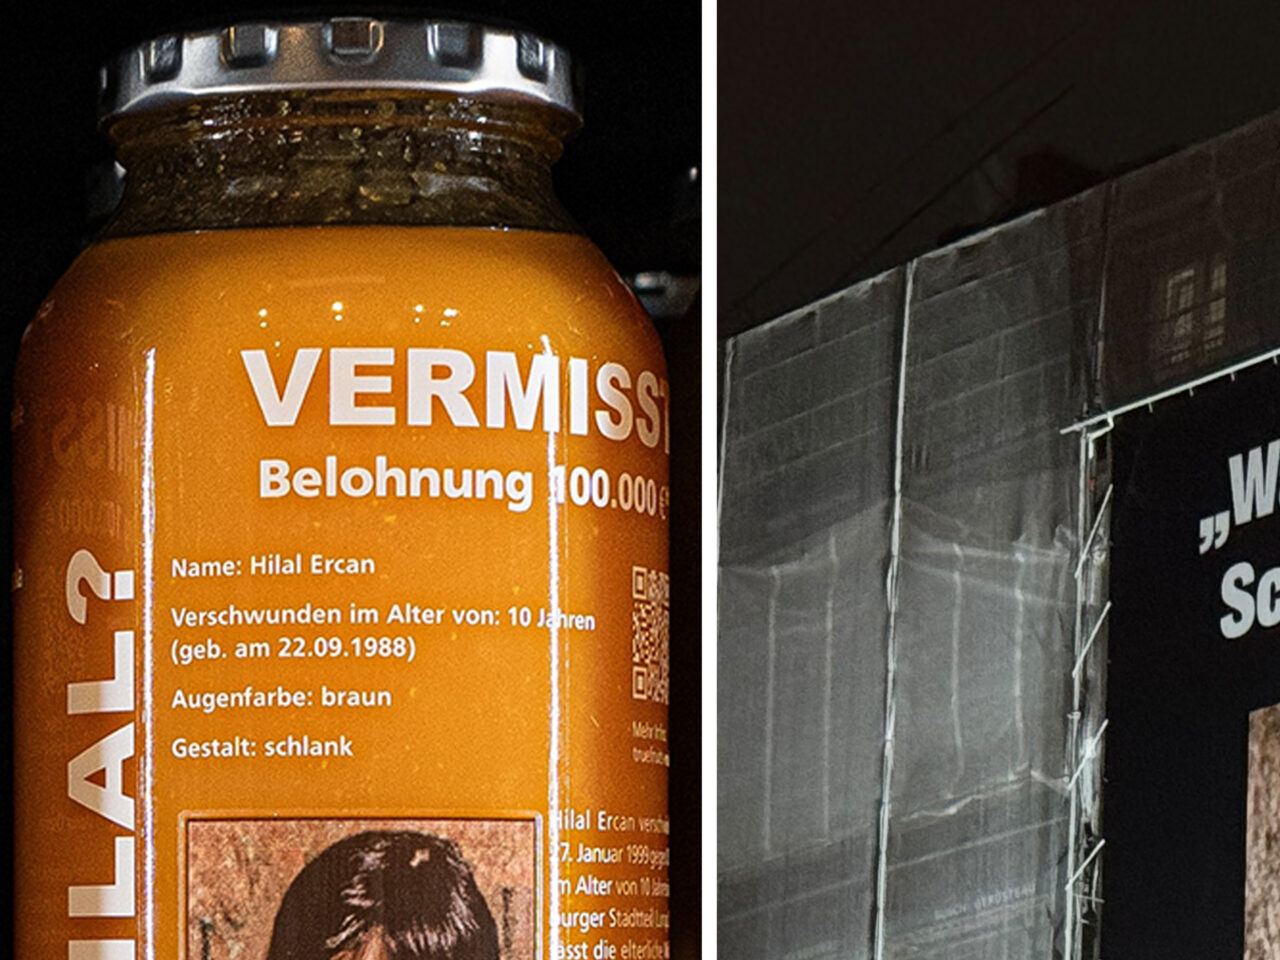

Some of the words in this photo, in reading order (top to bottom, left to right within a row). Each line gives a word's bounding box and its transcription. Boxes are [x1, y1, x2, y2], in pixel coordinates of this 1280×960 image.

[259, 456, 533, 513] Belohnung
[551, 465, 657, 516] 100.000
[171, 558, 242, 578] Name:
[250, 553, 301, 575] Hilal
[311, 554, 375, 574] Ercan
[171, 604, 342, 627] Verschwunden
[350, 603, 379, 623] im
[386, 603, 445, 624] Alter
[452, 609, 500, 625] von:
[508, 607, 532, 627] 10
[537, 607, 596, 631] Jahren
[171, 638, 227, 665] (geb.
[235, 642, 270, 657] am
[278, 636, 416, 662] 22.09.1988)
[171, 686, 313, 713] Augenfarbe:
[321, 686, 392, 707] braun
[171, 736, 256, 758] Gestalt:
[264, 735, 353, 756] schlank
[598, 810, 635, 832] Ercan
[577, 843, 623, 863] Januar
[575, 875, 613, 895] Alter
[615, 880, 638, 896] von
[593, 939, 616, 960] die
